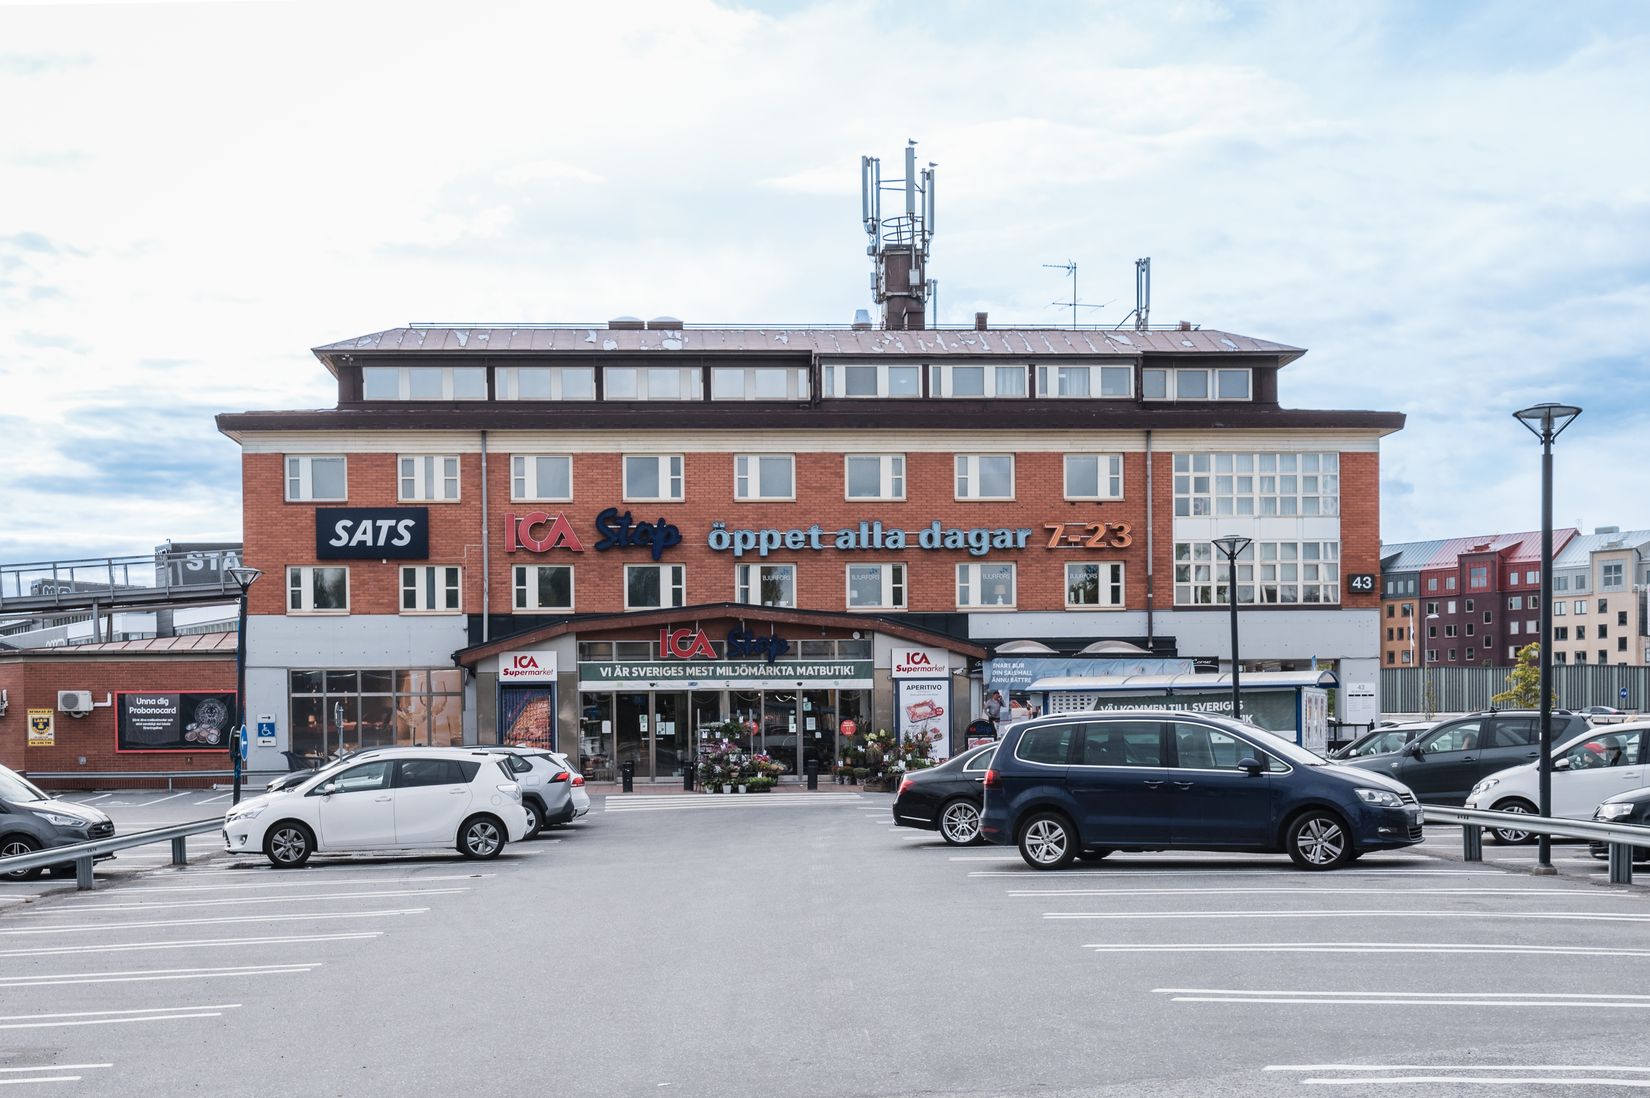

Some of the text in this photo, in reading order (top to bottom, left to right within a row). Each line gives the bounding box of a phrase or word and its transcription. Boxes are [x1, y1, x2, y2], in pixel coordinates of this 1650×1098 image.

[329, 519, 416, 547] SATS
[504, 507, 682, 561] ICA Stop
[707, 520, 1134, 557] öppet alla dagar 7-23
[1352, 576, 1372, 589] 43
[659, 625, 790, 664] ICA Stop
[513, 655, 539, 669] ICA
[905, 652, 931, 665] ICA
[503, 668, 553, 677] Supermarket
[600, 664, 855, 677] VI ÄR SVERIGES MEST MILJÖMÄRKTA MATBUTIK!
[896, 664, 945, 674] Supermarket
[157, 698, 169, 706] dig
[129, 706, 177, 714] Probonocard
